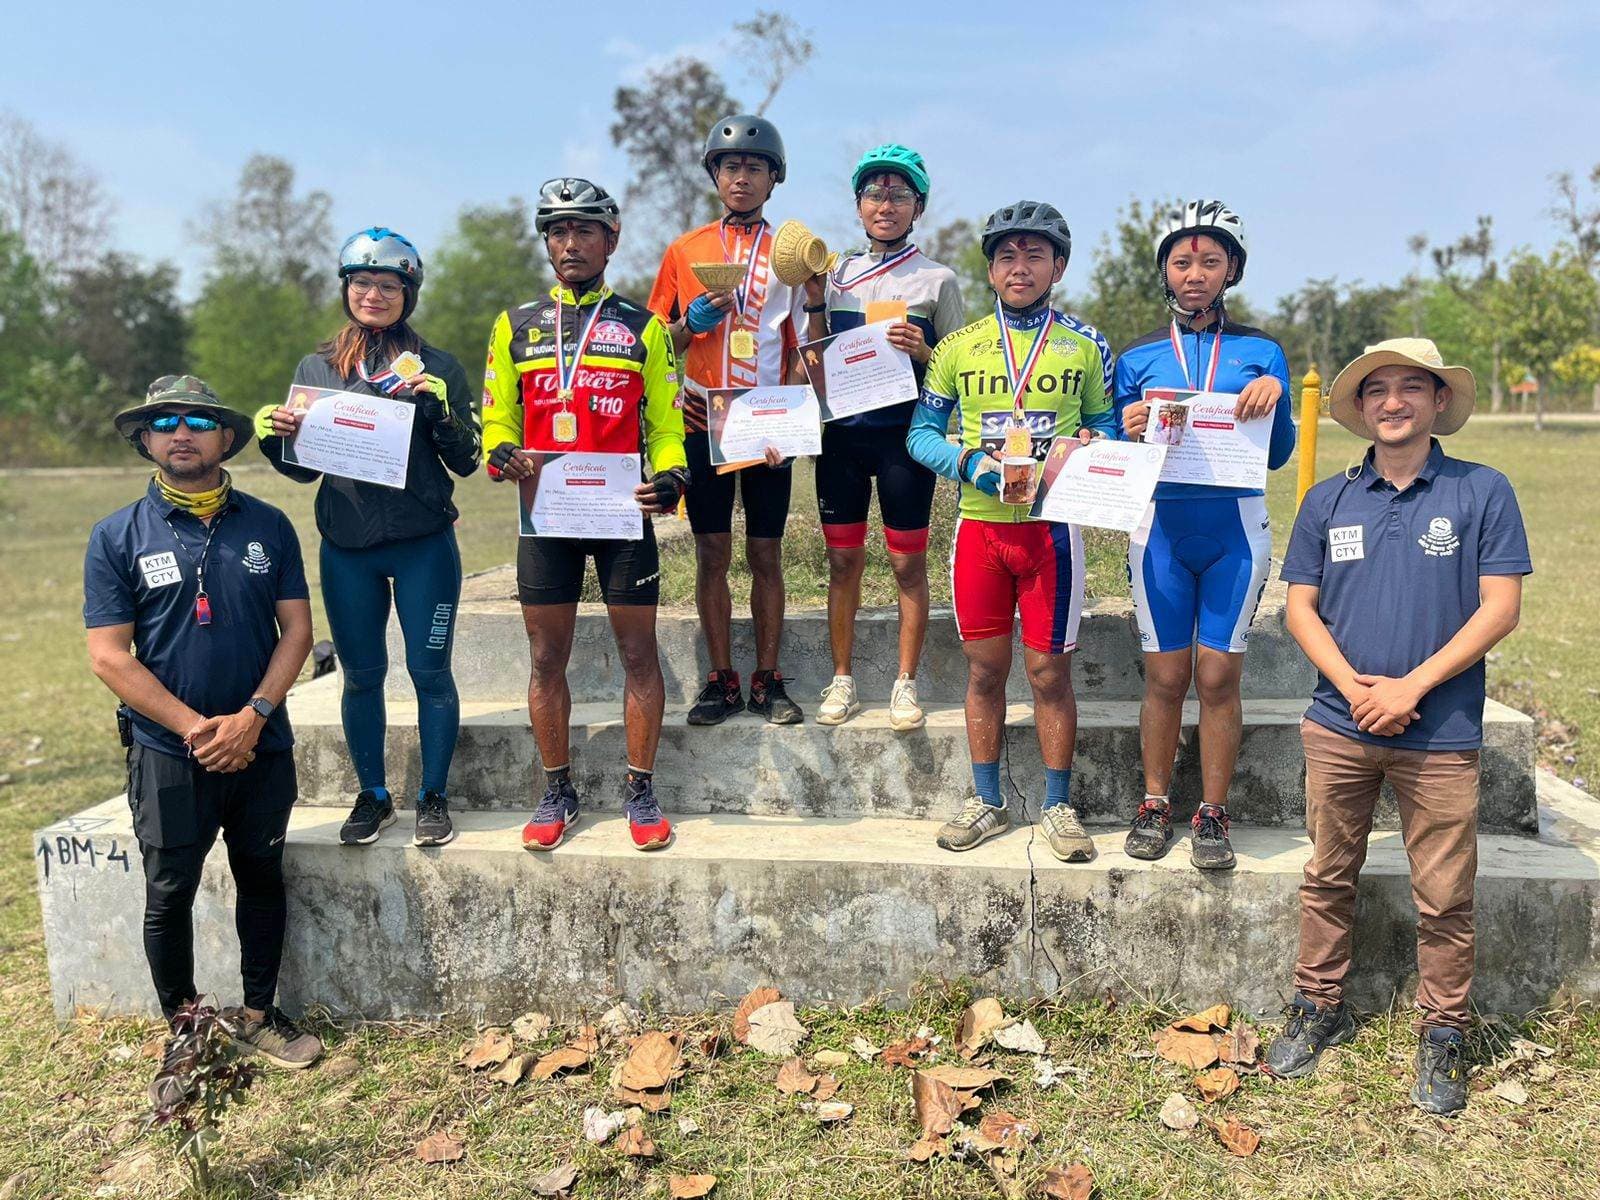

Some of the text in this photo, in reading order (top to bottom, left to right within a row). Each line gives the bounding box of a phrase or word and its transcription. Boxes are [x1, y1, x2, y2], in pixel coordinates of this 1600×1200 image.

[1027, 314, 1045, 327] SAX
[595, 332, 628, 343] NERI
[838, 336, 874, 352] Certificate
[591, 344, 632, 356] sottoli.it
[535, 369, 630, 391] Wlier
[599, 396, 623, 414] 110
[749, 395, 788, 406] Certificate
[334, 400, 380, 417] Certificate
[1193, 402, 1235, 416] Certificat
[986, 415, 1055, 434] SAXO
[562, 462, 607, 473] Certificate
[1333, 529, 1358, 541] KTM
[1335, 546, 1357, 558] CTY
[144, 555, 172, 569] KTM
[150, 570, 175, 584] CTY
[425, 603, 453, 650] LAMEDA
[56, 836, 129, 873] BM-4
